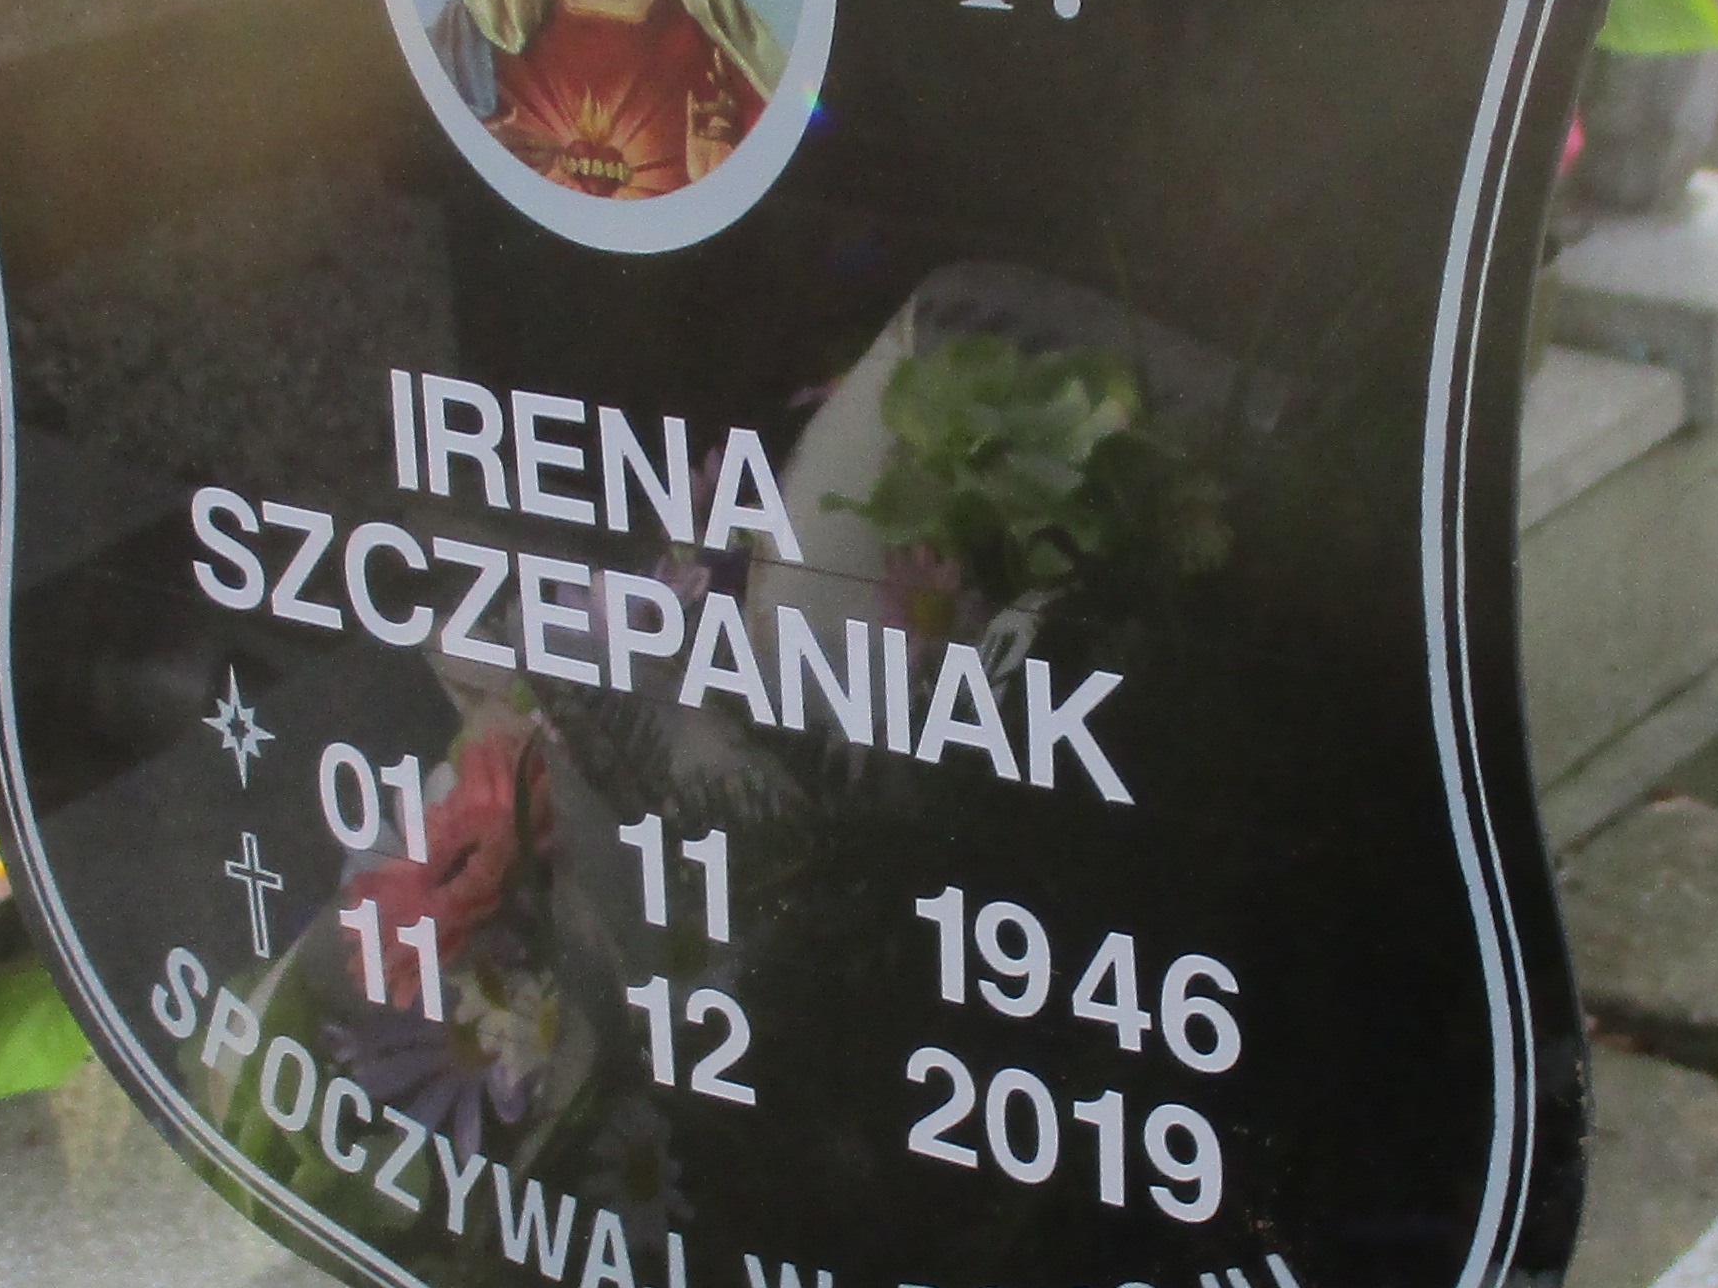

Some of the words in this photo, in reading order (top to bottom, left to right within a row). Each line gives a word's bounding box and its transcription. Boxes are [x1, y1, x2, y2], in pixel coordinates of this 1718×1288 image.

[389, 367, 805, 564] IRENA
[190, 485, 1135, 805] SZCZEPANIAK
[318, 741, 428, 865] 01
[617, 811, 731, 943] 11
[914, 885, 1242, 1074] 1946
[337, 897, 445, 1023] 11
[625, 974, 757, 1106] 12
[905, 1046, 1224, 1224] 2019
